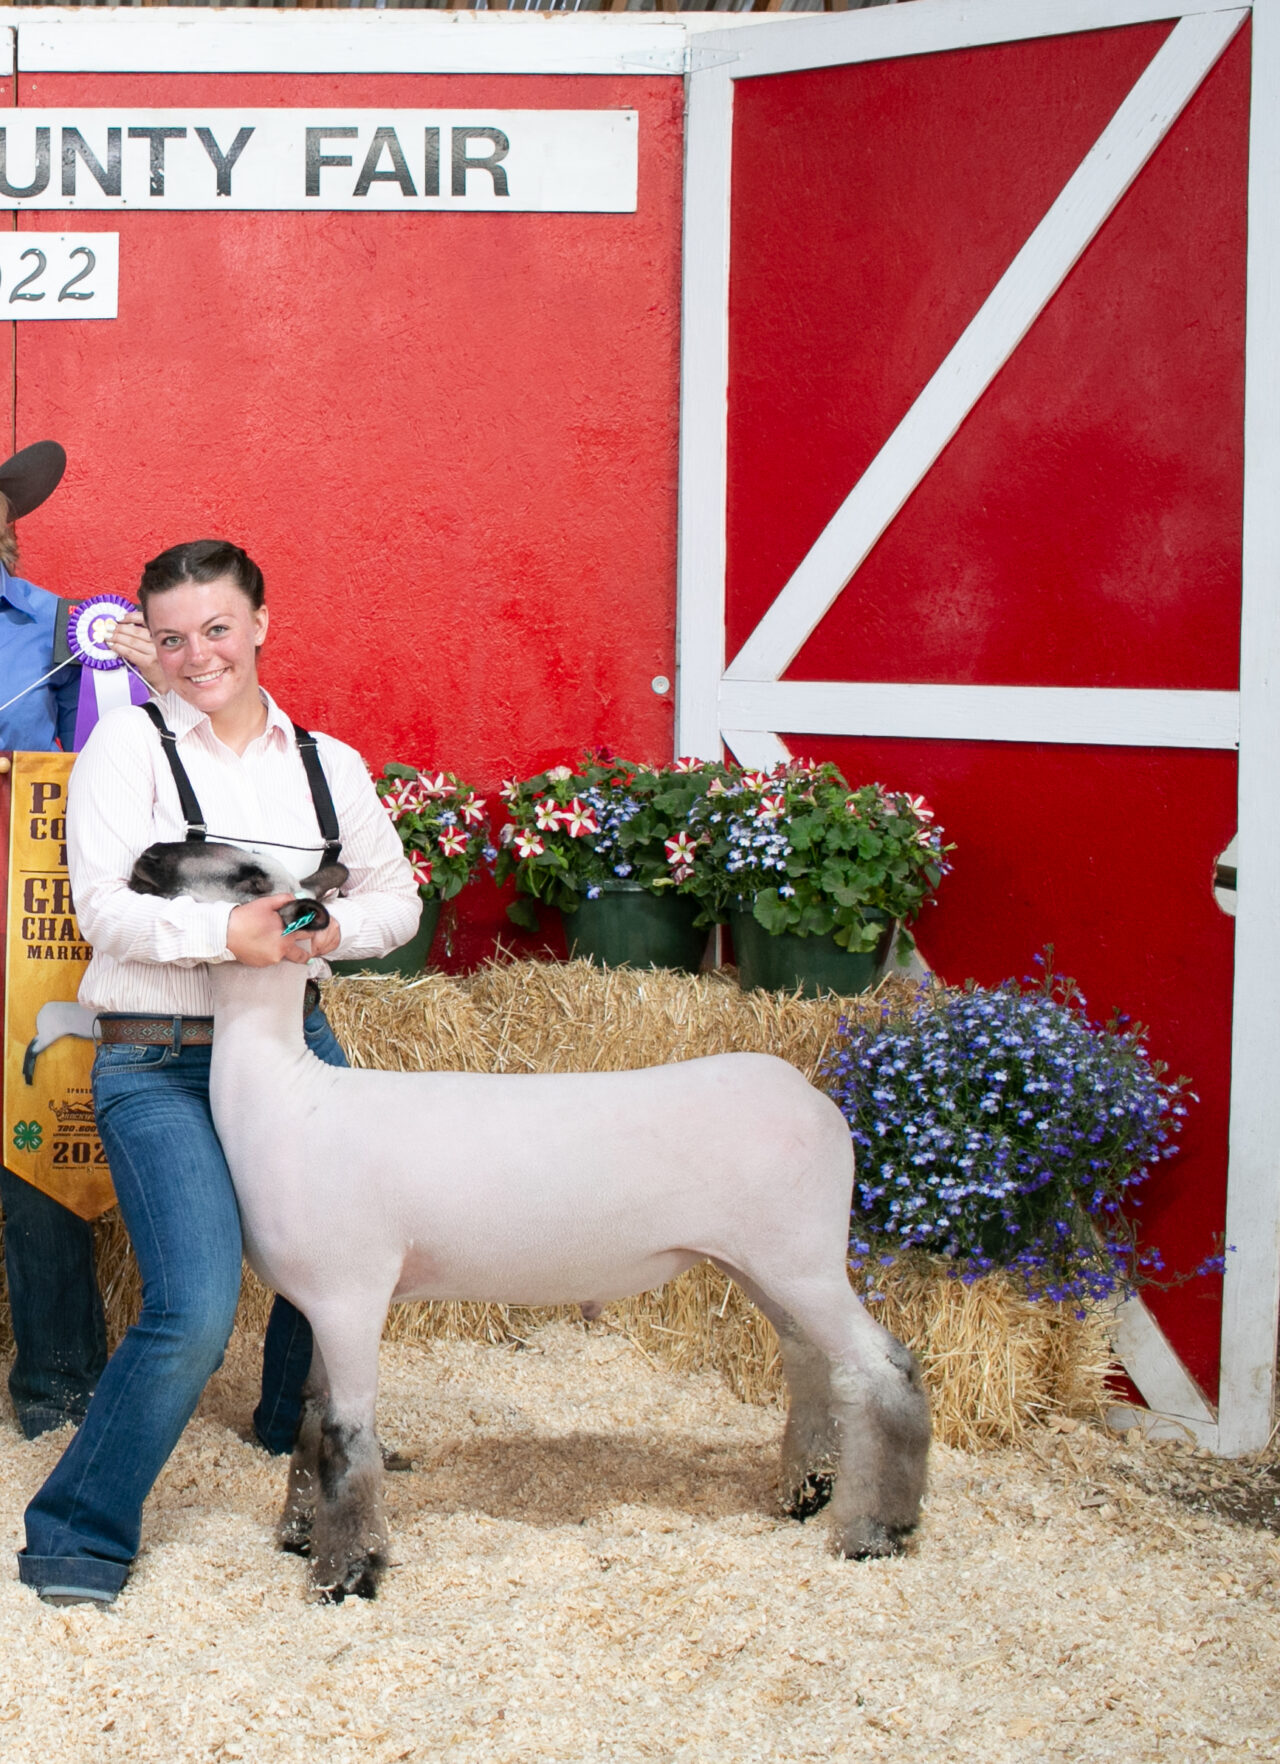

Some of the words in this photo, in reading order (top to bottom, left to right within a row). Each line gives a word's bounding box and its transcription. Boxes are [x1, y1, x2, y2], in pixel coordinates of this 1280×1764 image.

[305, 126, 511, 197] FAIR
[30, 817, 66, 841] CO
[24, 877, 76, 915] GR
[21, 916, 85, 942] CHA
[26, 944, 94, 961] MARKE
[53, 1141, 110, 1165] 202
